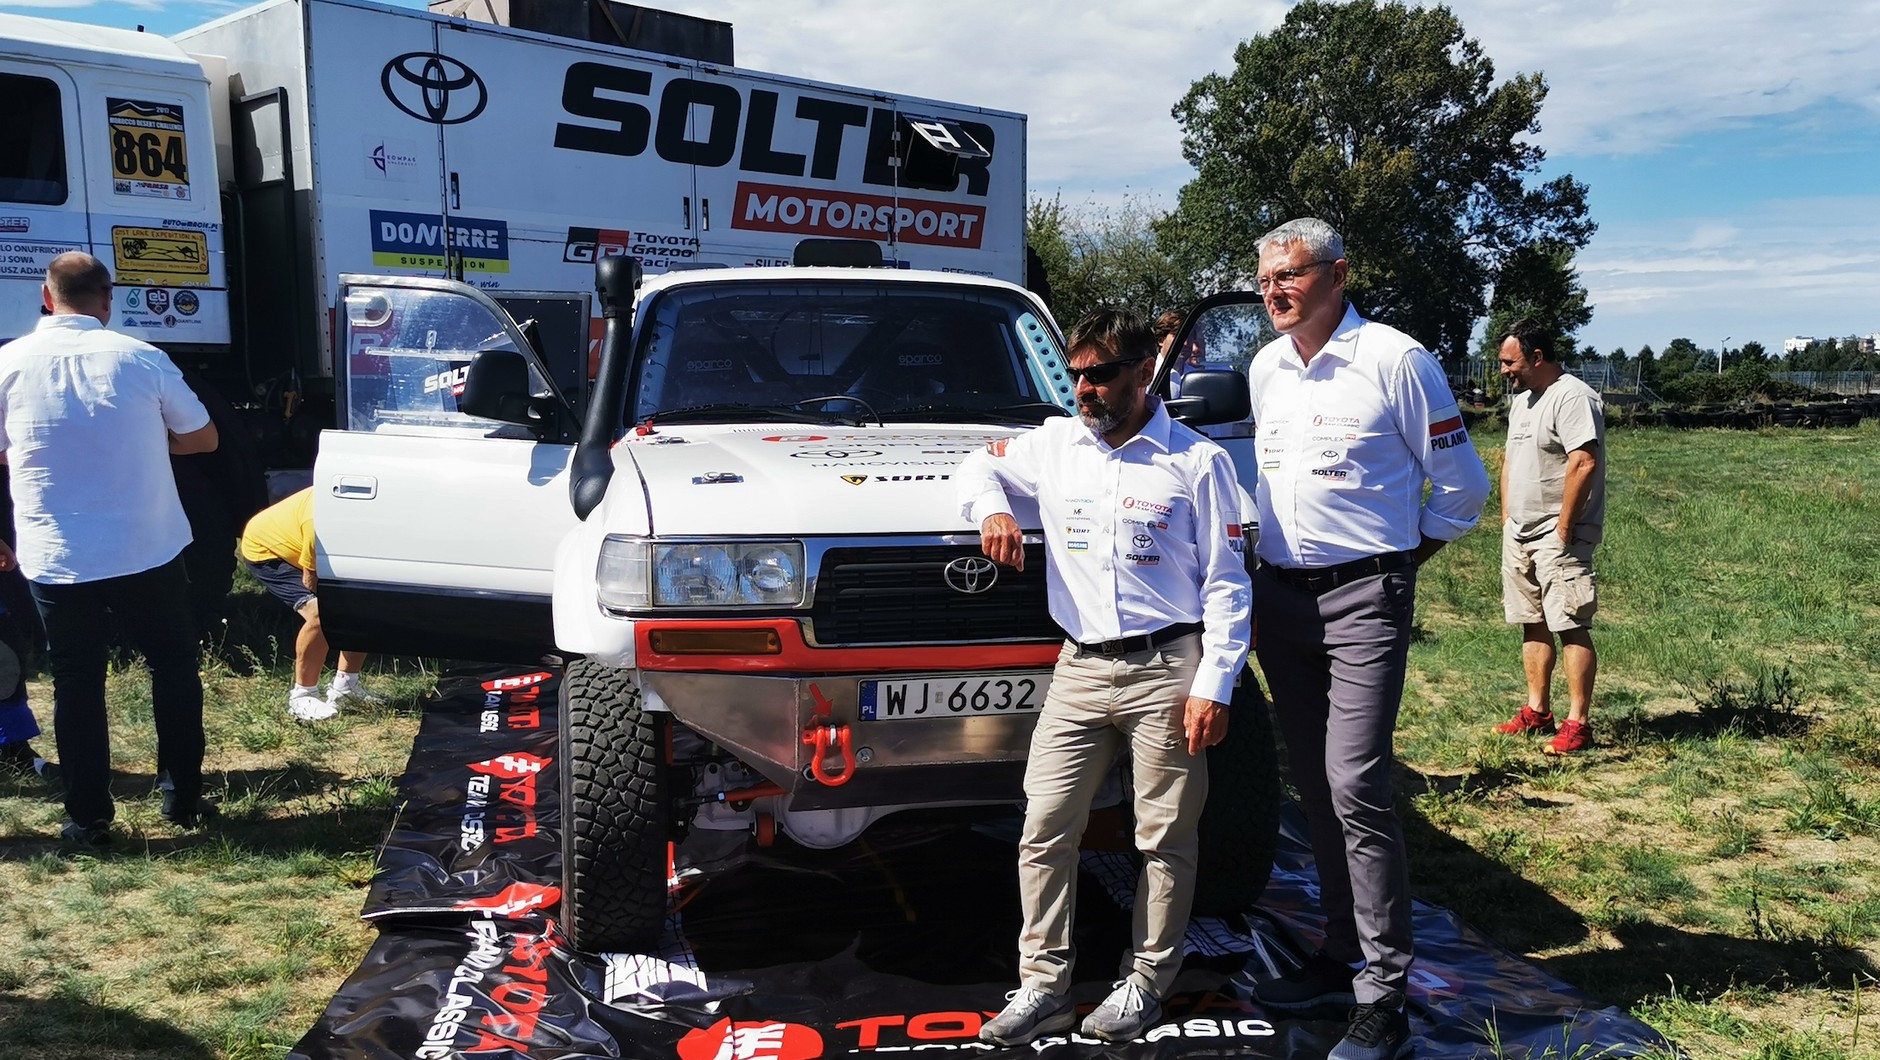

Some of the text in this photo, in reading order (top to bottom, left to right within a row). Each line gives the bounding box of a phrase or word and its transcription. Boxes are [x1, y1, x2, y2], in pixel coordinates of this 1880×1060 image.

[554, 61, 995, 197] SOLTER
[113, 130, 187, 178] 864
[744, 192, 979, 239] MOTORSPORT
[634, 232, 700, 247] TOYOTA
[631, 244, 693, 258] GAZOO
[8, 255, 35, 264] SOWA
[401, 256, 486, 269] SUSPEION
[687, 358, 733, 372] sparco
[899, 353, 943, 366] sparco
[1324, 416, 1360, 424] TOYOTA
[1312, 435, 1344, 443] COMPLEX
[1431, 430, 1468, 452] POLAND
[1311, 468, 1347, 478] SOLTER
[1136, 500, 1173, 514] TOYOTA
[1122, 518, 1157, 530] COMPLEX
[1125, 553, 1160, 563] SOLTER
[862, 704, 875, 715] PL
[948, 678, 1046, 713] 6632
[414, 963, 486, 1060] CLASSIC
